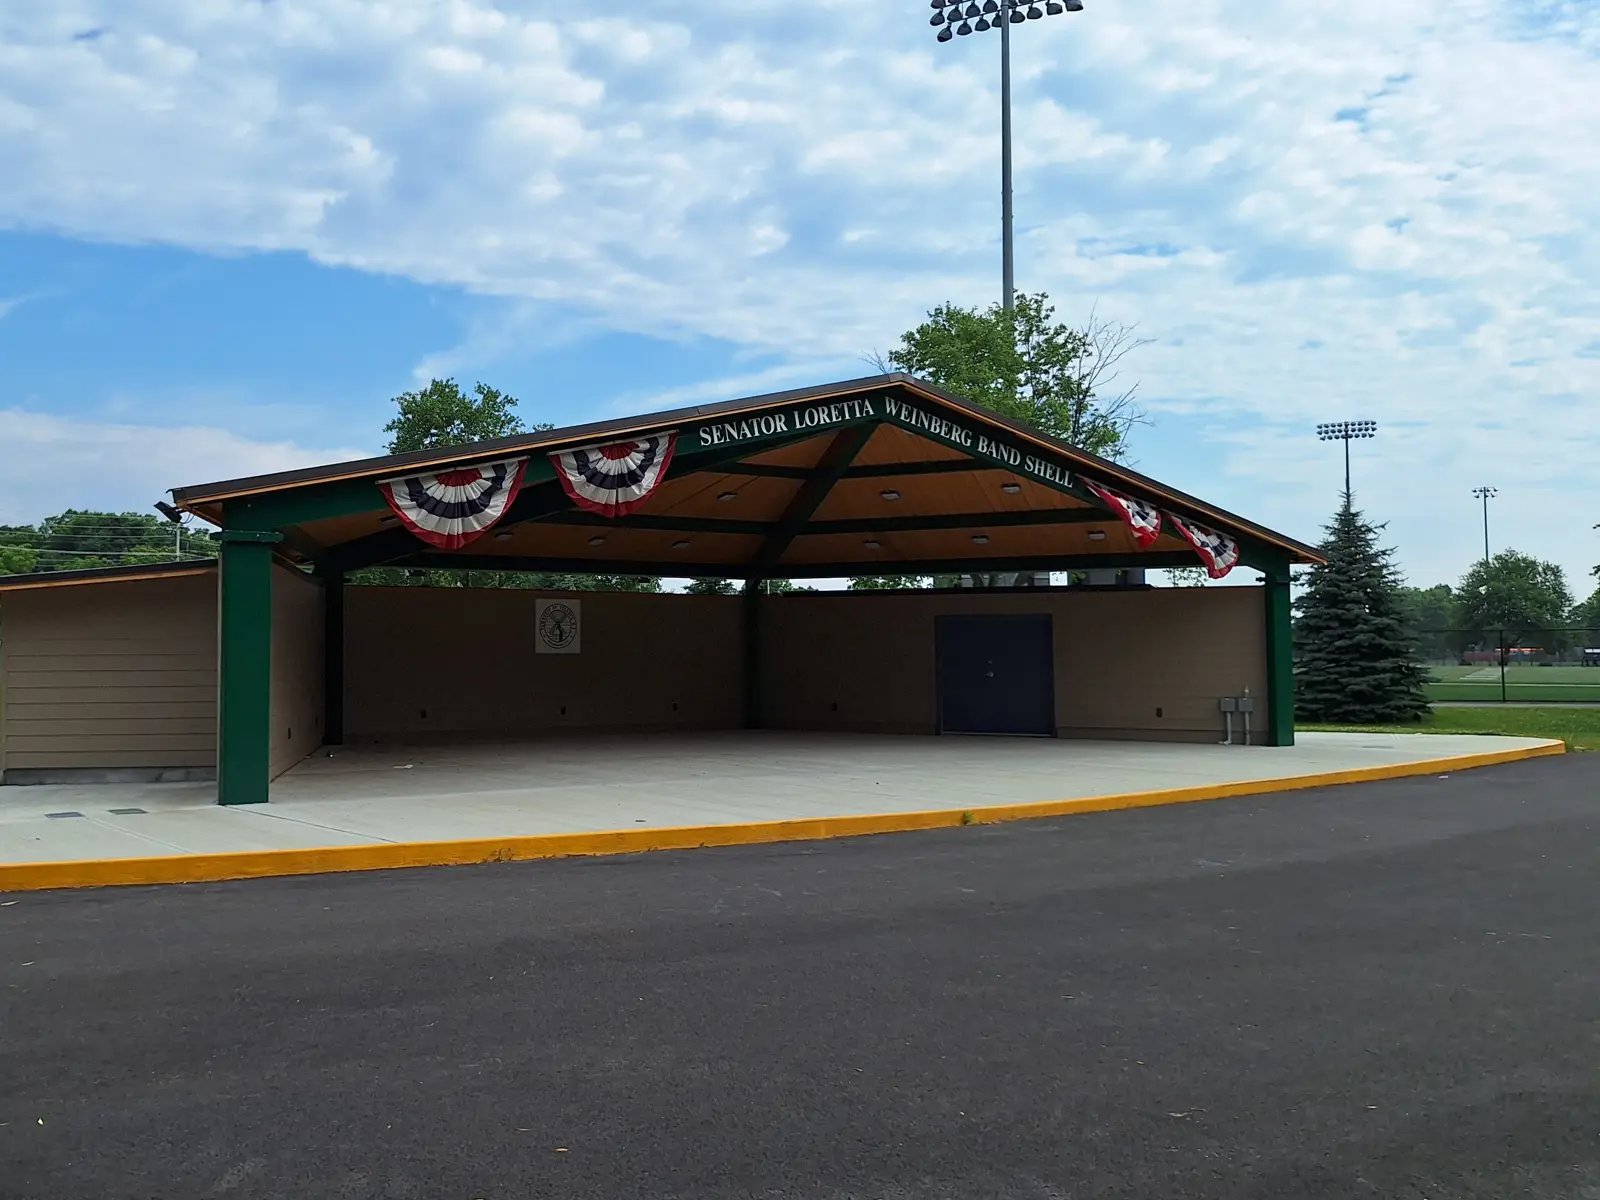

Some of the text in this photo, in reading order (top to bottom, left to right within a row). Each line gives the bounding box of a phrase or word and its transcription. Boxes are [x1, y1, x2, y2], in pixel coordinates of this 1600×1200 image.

[700, 397, 1073, 488] SENATOR LORETTA WEINBERG BAND SHELL
